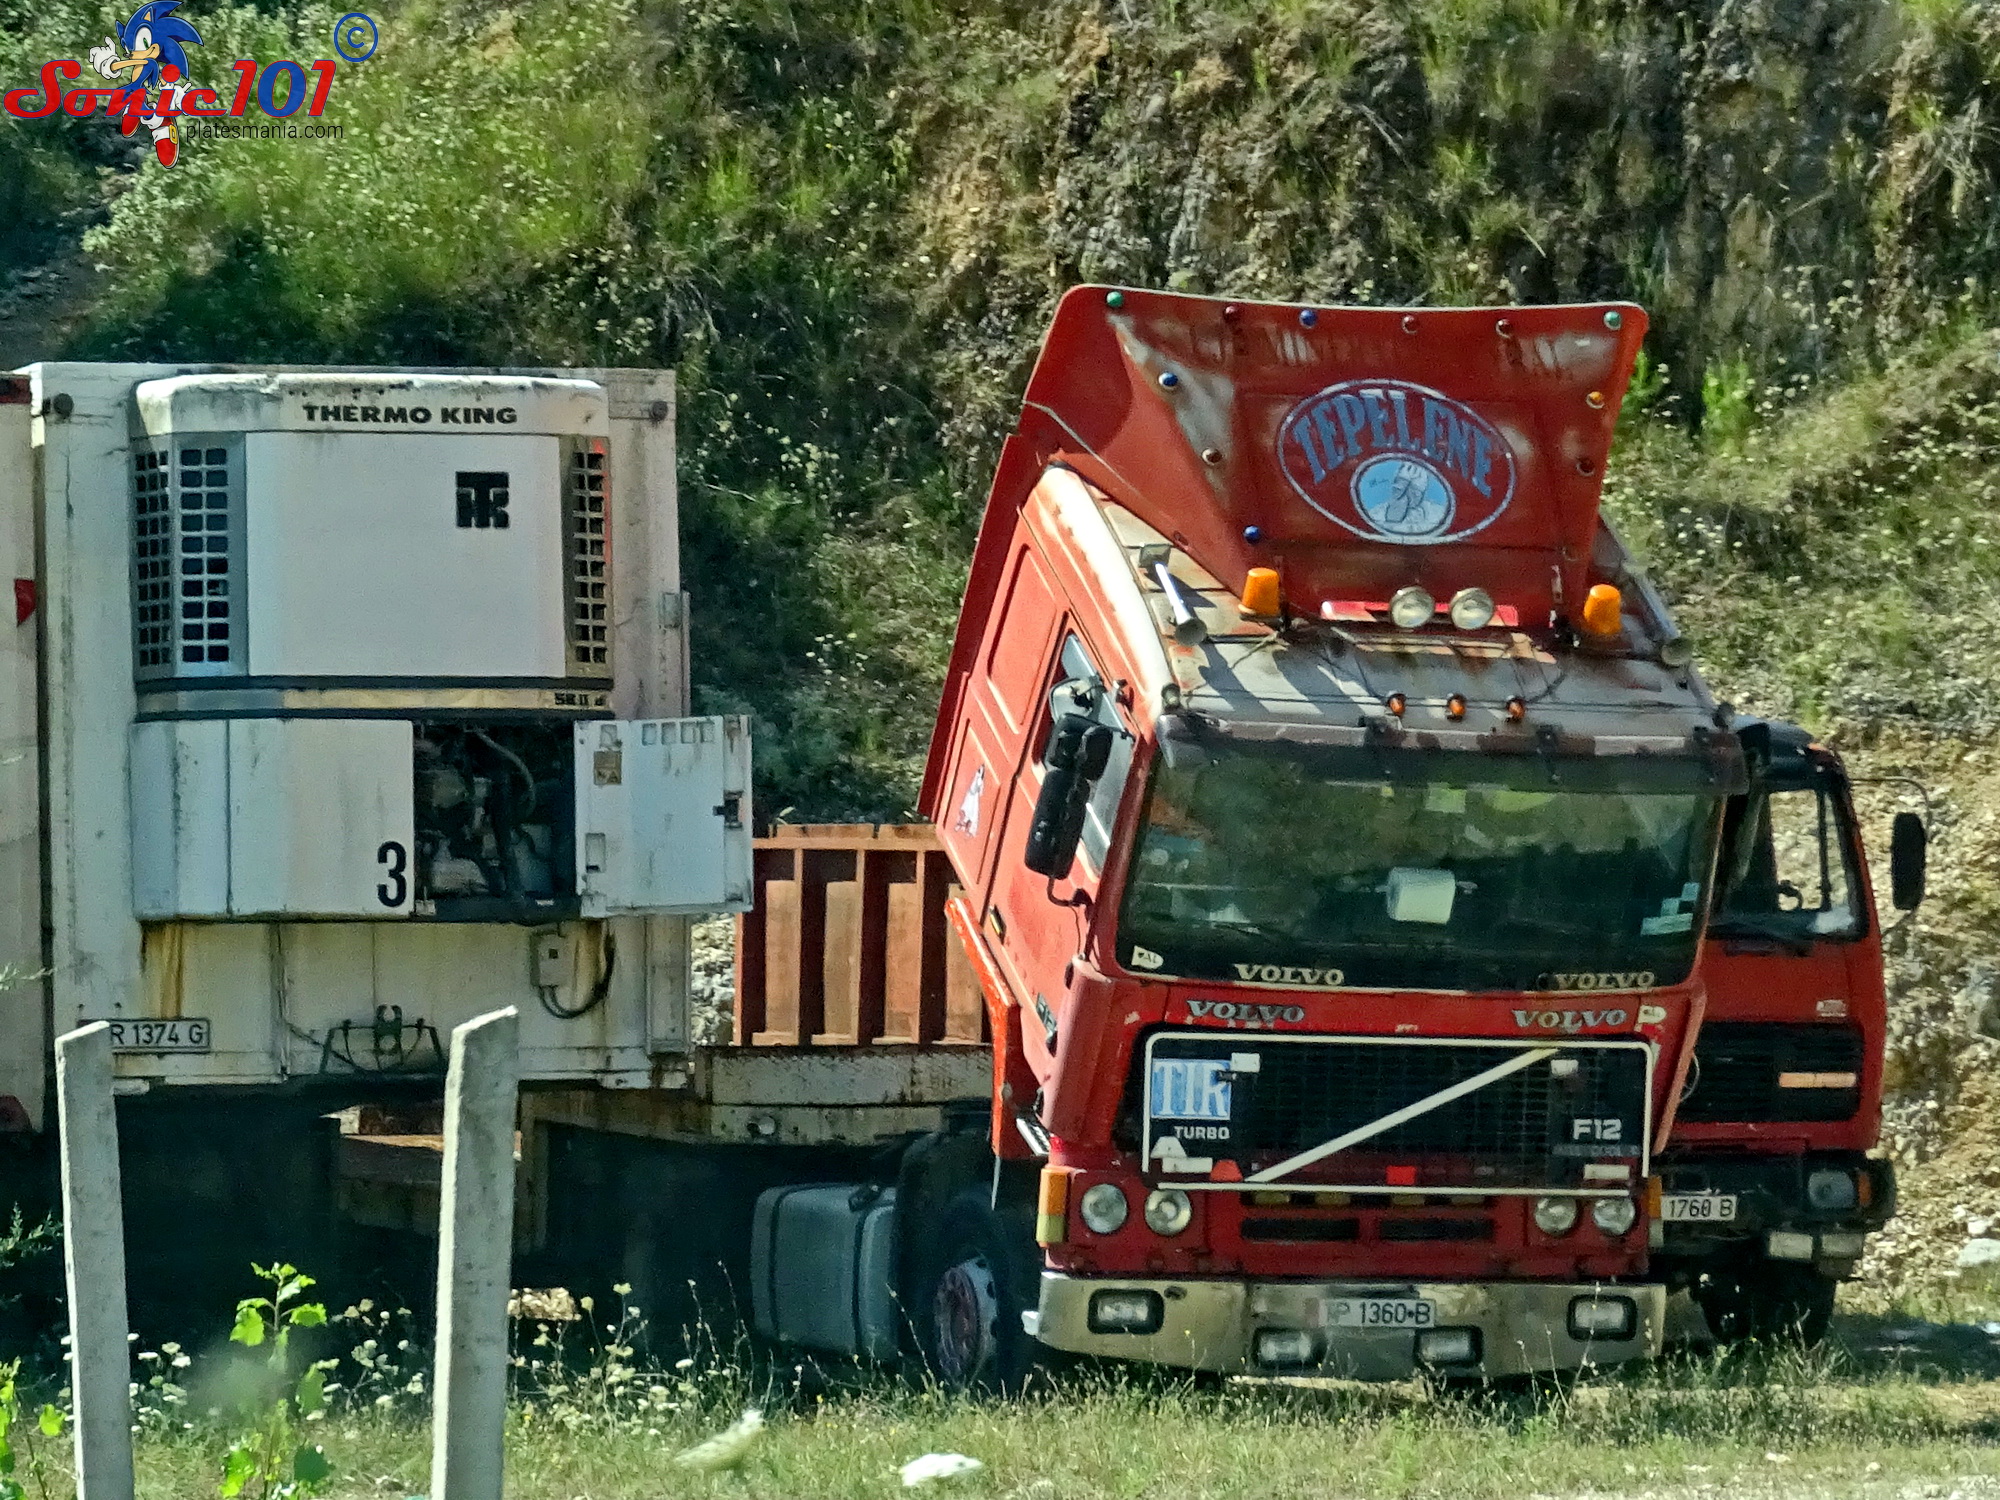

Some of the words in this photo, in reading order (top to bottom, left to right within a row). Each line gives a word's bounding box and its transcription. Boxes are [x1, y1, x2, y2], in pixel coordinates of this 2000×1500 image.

[302, 405, 433, 425] THERMO
[440, 406, 518, 425] KING
[1293, 388, 1492, 498] TEPELENE
[377, 841, 407, 907] 3
[1234, 963, 1344, 985] VOLVO
[1554, 971, 1655, 989] VOLVO
[1186, 1000, 1305, 1023] VOLVO
[1512, 1009, 1627, 1030] VOLVO
[133, 1023, 179, 1044] 1374
[188, 1023, 203, 1044] G
[1152, 1061, 1229, 1117] TIR
[1173, 1126, 1230, 1140] TURBO
[1573, 1119, 1622, 1140] F12
[1719, 1198, 1733, 1217] B
